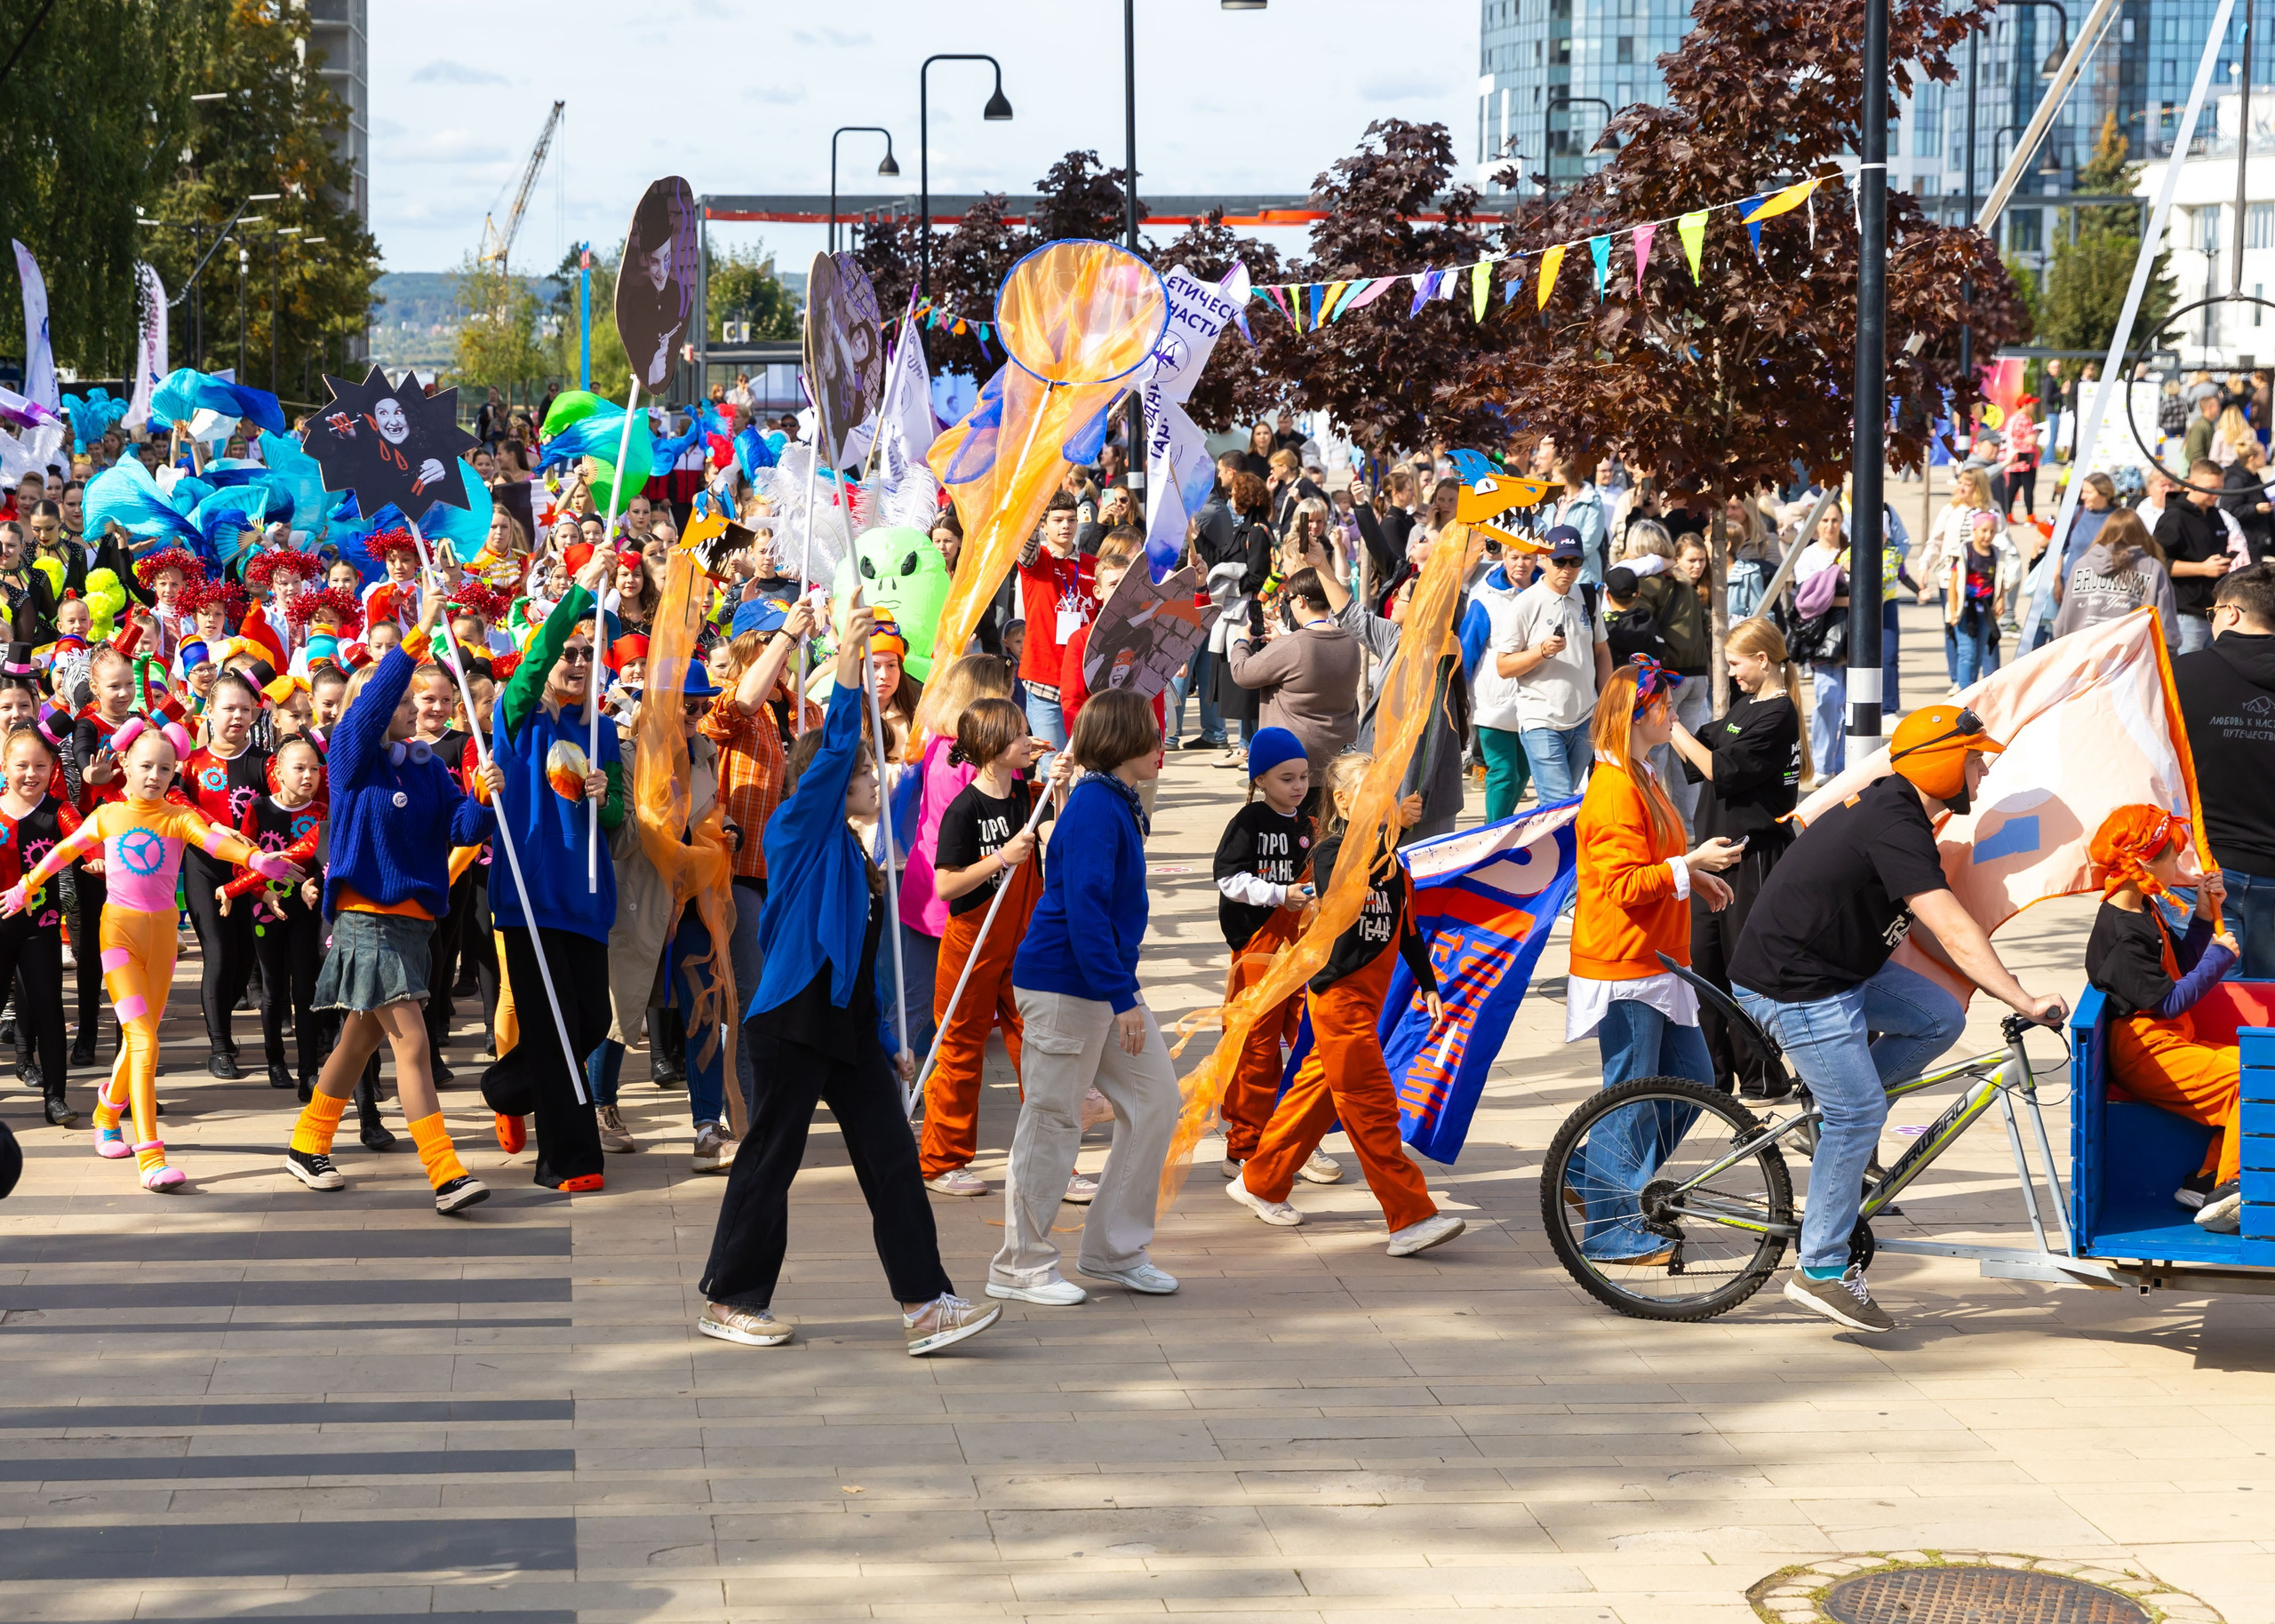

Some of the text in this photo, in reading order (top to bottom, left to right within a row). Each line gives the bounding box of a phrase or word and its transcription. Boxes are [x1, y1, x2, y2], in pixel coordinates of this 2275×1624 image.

[2209, 716, 2244, 726] ЛЮБОВЬ
[2247, 718, 2253, 727] К
[1880, 1094, 1968, 1196] FORWARD
